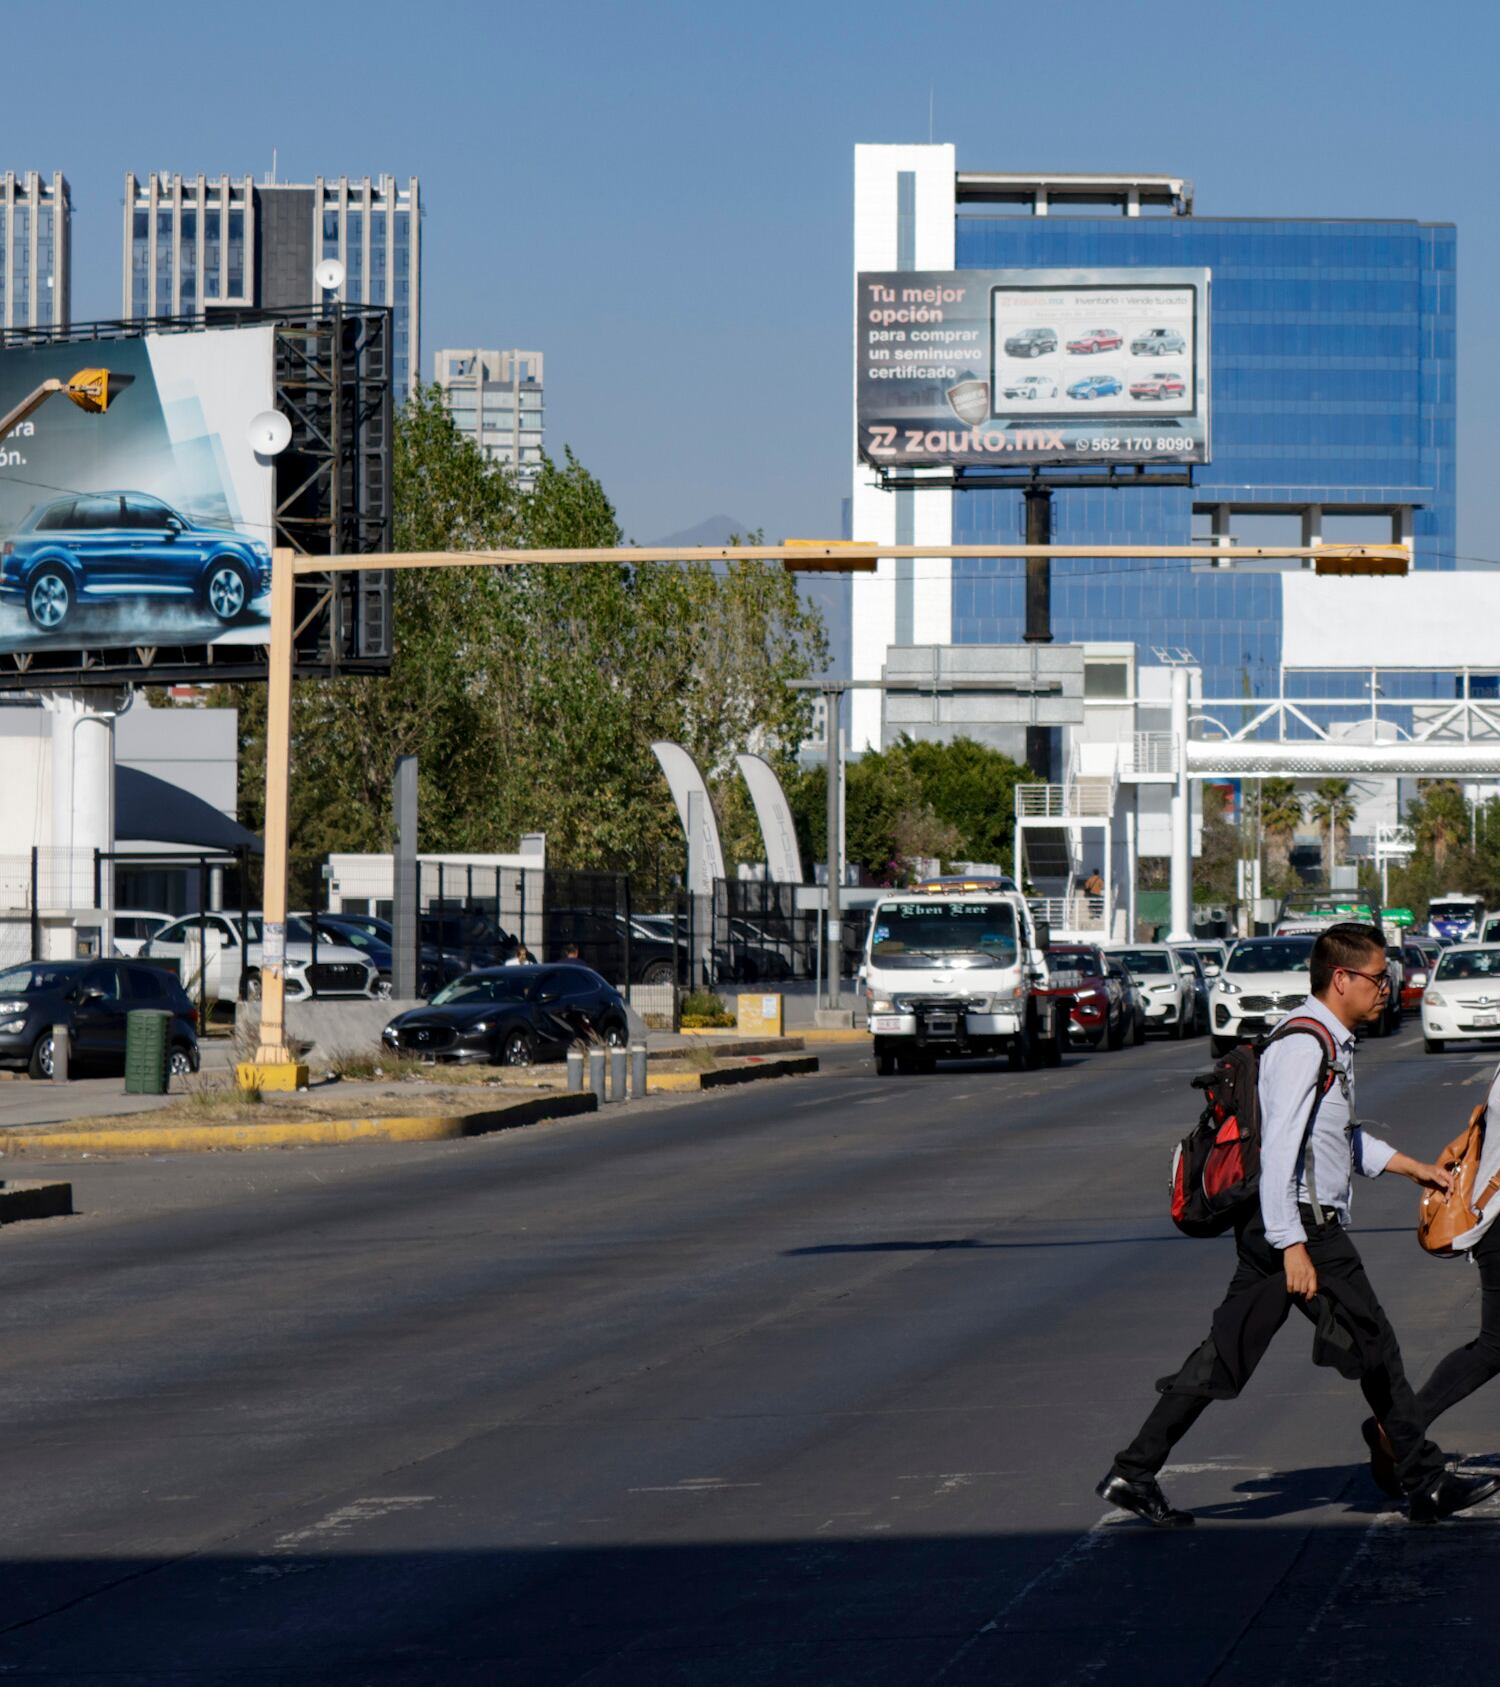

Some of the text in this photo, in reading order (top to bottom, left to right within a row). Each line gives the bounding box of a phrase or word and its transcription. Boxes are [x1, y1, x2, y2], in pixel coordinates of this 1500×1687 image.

[868, 285, 966, 306] Tu mejor
[869, 306, 943, 326] opción
[869, 330, 979, 343] para comprar
[869, 347, 982, 360] un seminuevo
[869, 365, 956, 379] certificado
[905, 427, 1066, 453] zauto.mx
[1092, 438, 1194, 451] 562 170 8090
[900, 903, 989, 918] Eben Ezer
